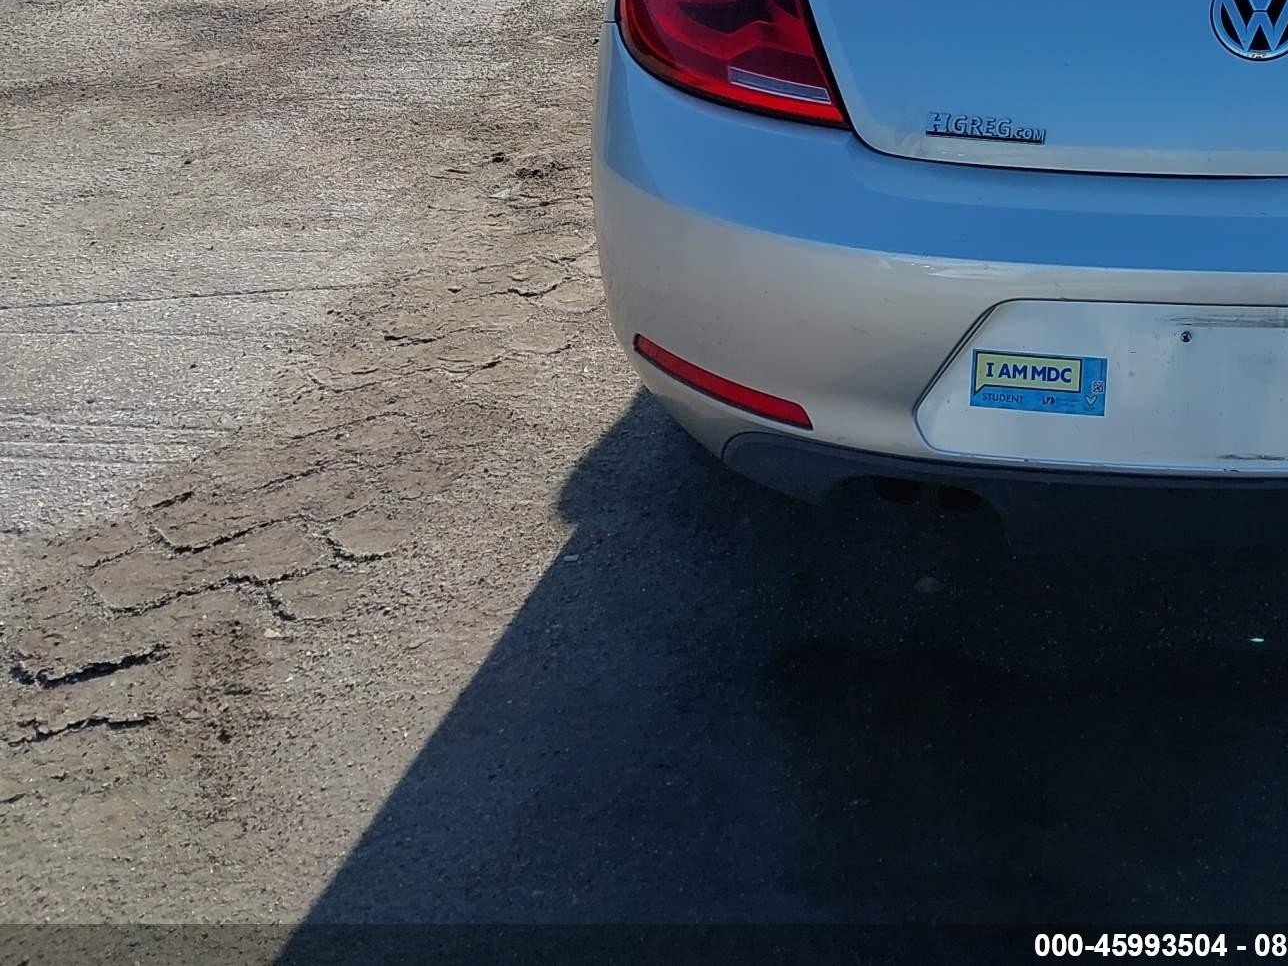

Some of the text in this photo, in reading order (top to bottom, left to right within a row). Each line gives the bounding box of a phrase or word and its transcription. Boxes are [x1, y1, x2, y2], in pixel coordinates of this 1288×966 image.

[986, 362, 1072, 383] I AM MDC
[982, 393, 1024, 403] STUDENT
